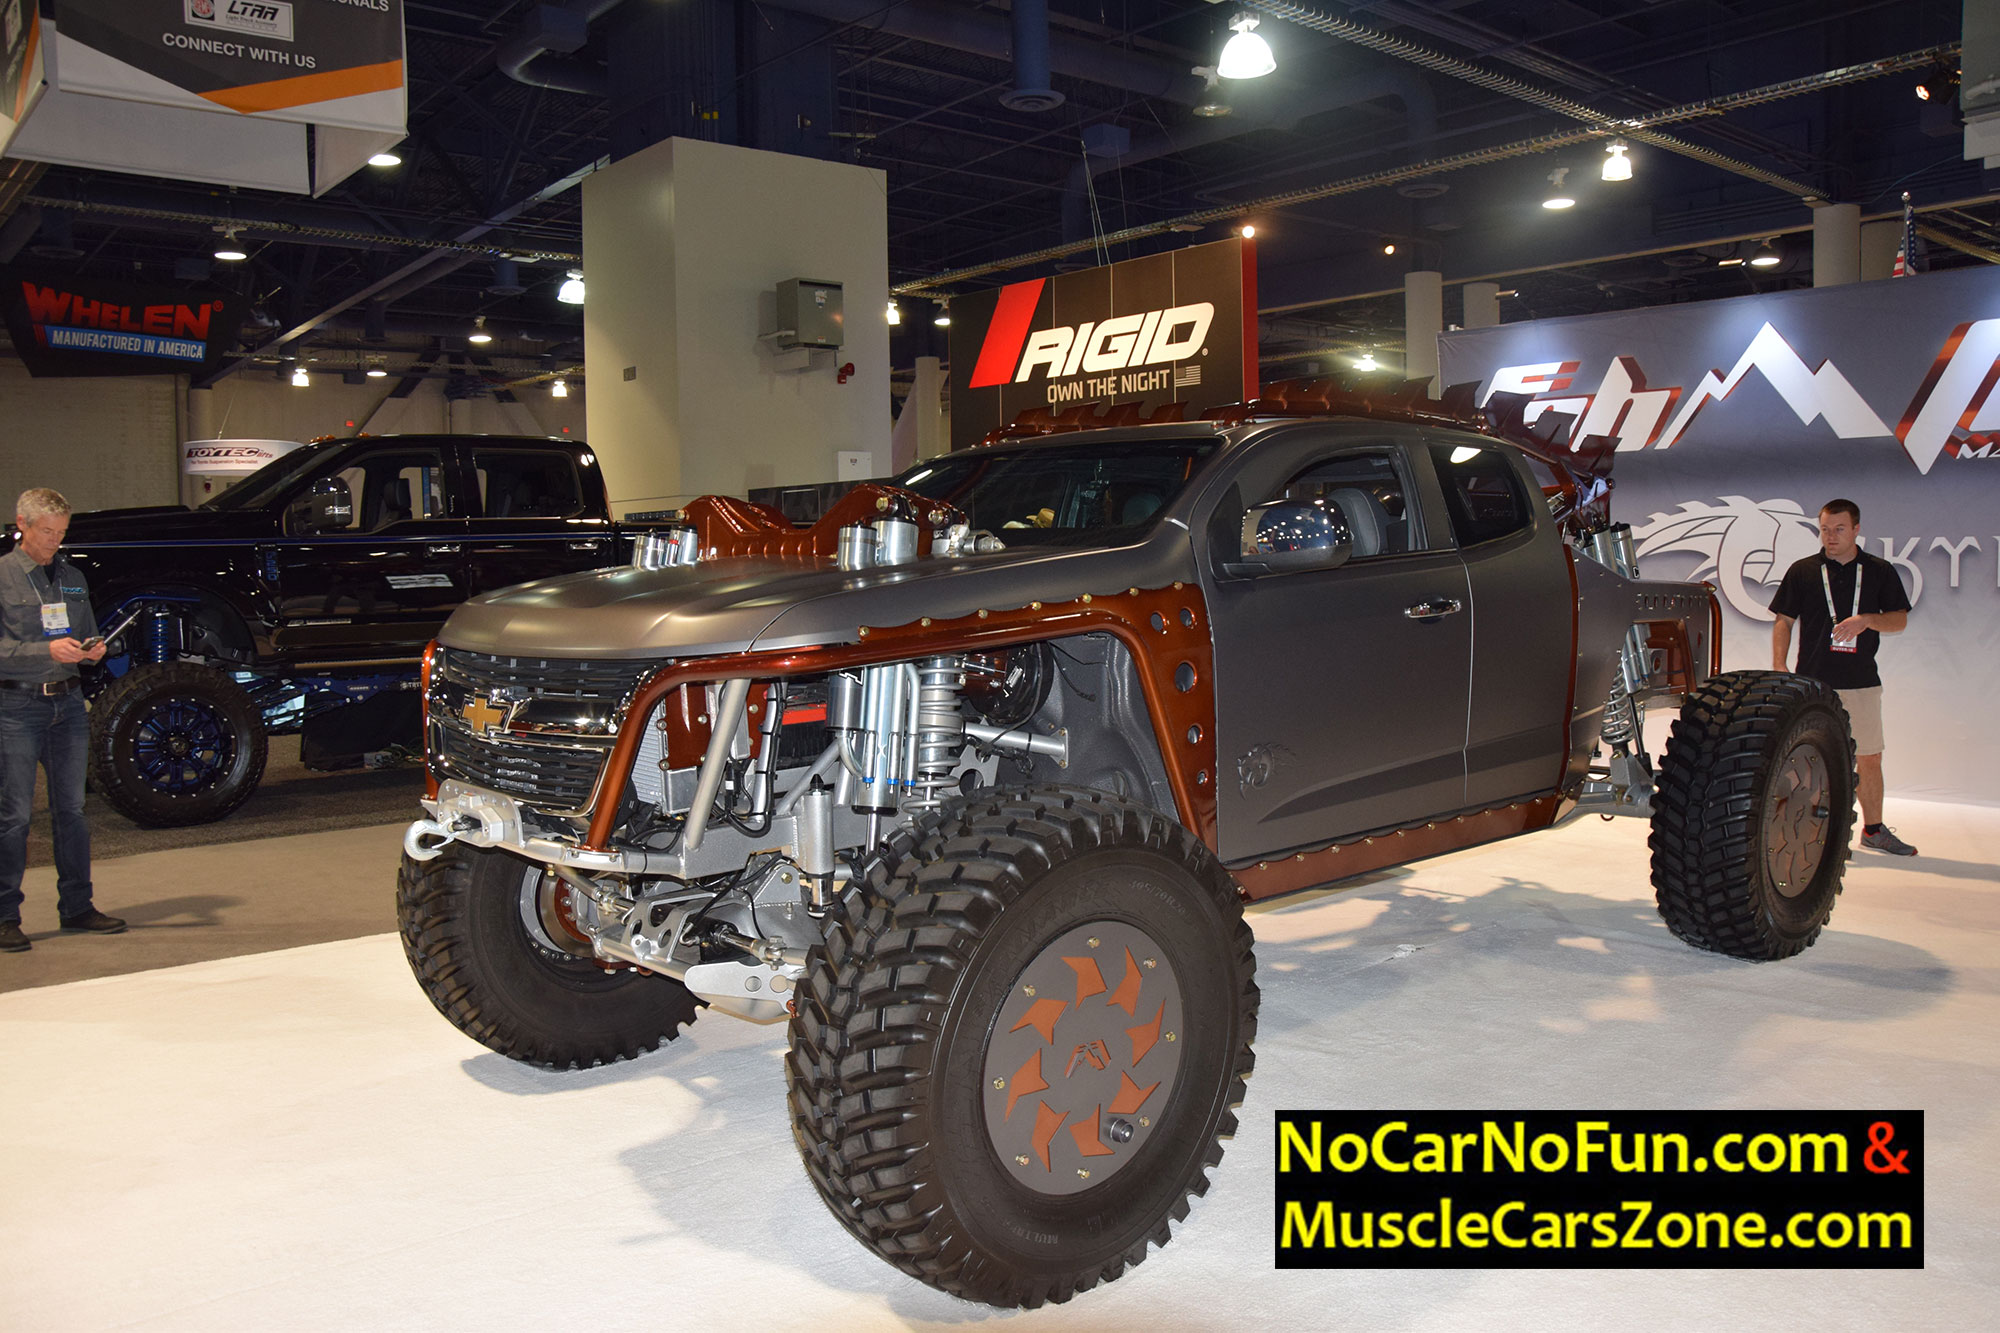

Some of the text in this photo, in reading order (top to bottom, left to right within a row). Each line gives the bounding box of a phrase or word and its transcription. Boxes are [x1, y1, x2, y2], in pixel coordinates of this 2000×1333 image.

[162, 33, 317, 69] CONNECT WITH US
[22, 281, 211, 340] WHELEN
[52, 330, 203, 359] MANUFACTURED IN AMERICA
[1015, 302, 1215, 383] RIGID
[1047, 369, 1171, 403] OWN THE NIGHT
[188, 447, 260, 458] TOYTEC
